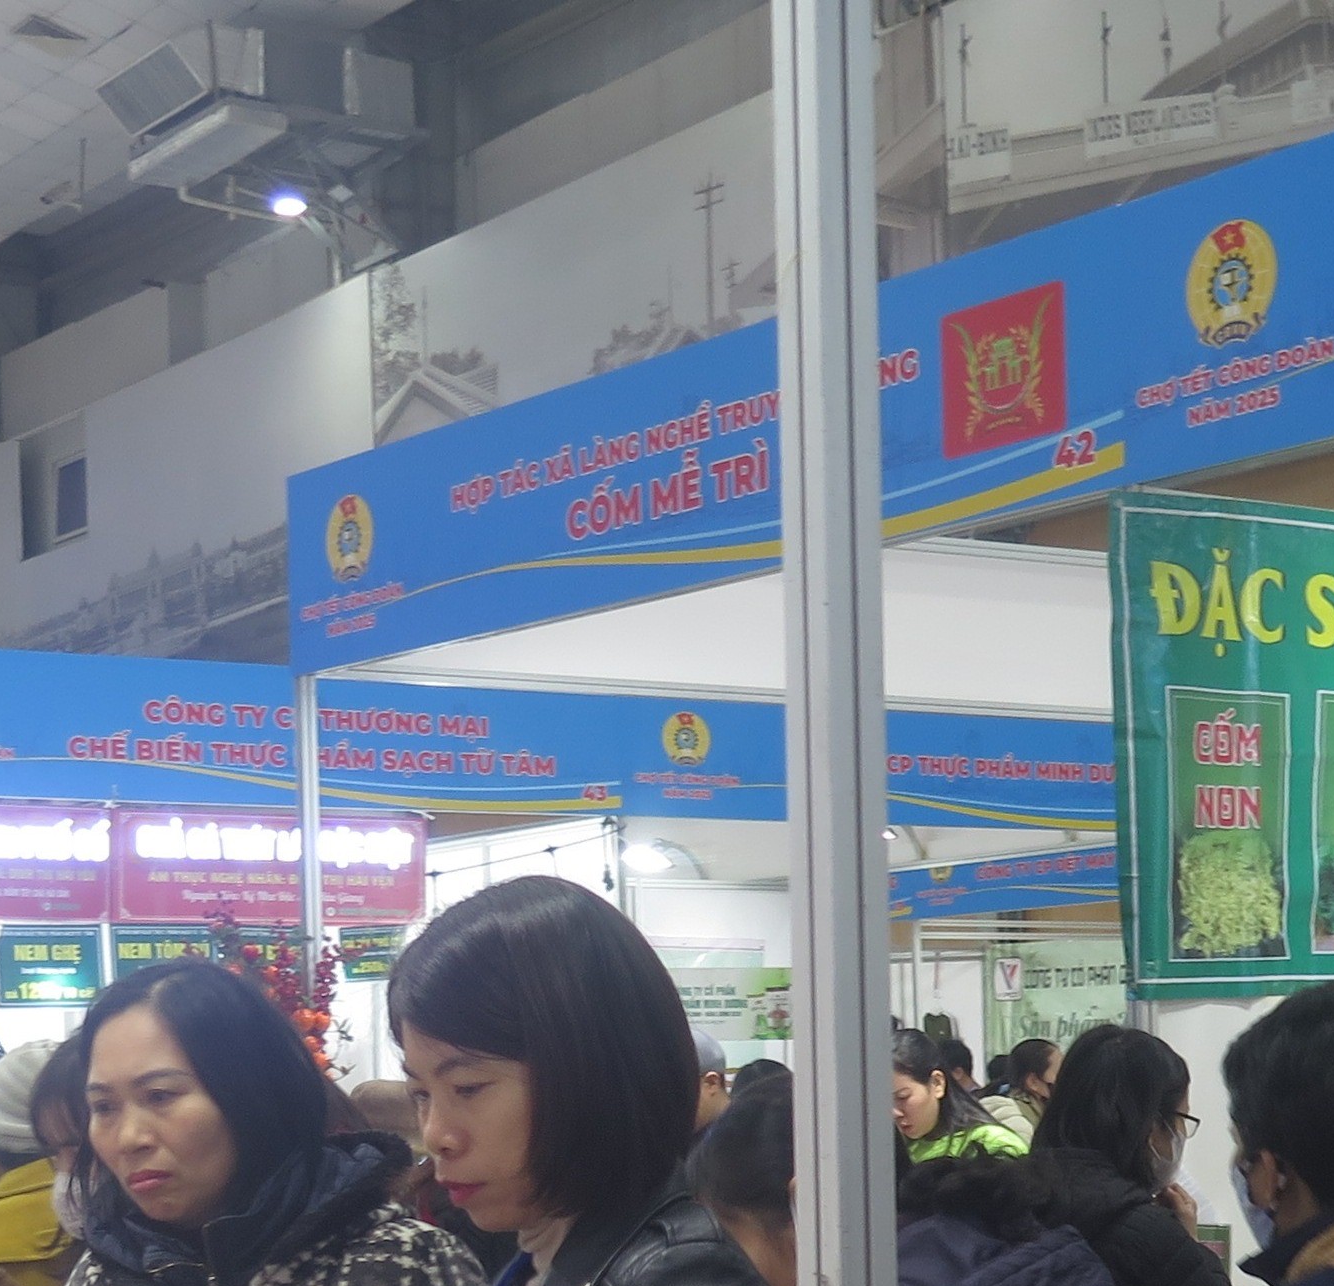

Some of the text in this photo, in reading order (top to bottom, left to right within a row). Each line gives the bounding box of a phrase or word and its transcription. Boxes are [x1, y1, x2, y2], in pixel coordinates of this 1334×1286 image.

[1136, 377, 1179, 410] CHỢ
[1179, 364, 1216, 398] TẾT
[1216, 356, 1272, 388] CÔNG
[1186, 385, 1282, 429] NĂM 2025
[450, 474, 495, 514] HỢP
[499, 459, 543, 498] TÁC
[543, 444, 577, 484] XÃ
[580, 434, 641, 475] LÀNG
[645, 401, 712, 455] NGHỀ
[1052, 429, 1097, 468] 42
[566, 437, 771, 541] CỐM MỄ TRÌ
[1149, 547, 1285, 658] ĐẶC
[143, 695, 491, 744] CÔNG TY C THƯƠNG MẠI
[1192, 708, 1262, 770] CỐM
[69, 729, 557, 778] CHẾ BIẾN THỰC HẨM SẠCH TỪ TÂM
[886, 755, 913, 775] CP
[918, 753, 970, 782] THỰC
[975, 752, 1031, 780] PHẨM
[1036, 763, 1084, 783] MINH
[581, 784, 609, 802] 43
[1192, 786, 1262, 830] NON
[14, 944, 49, 961] NEM
[118, 942, 152, 960] NEM
